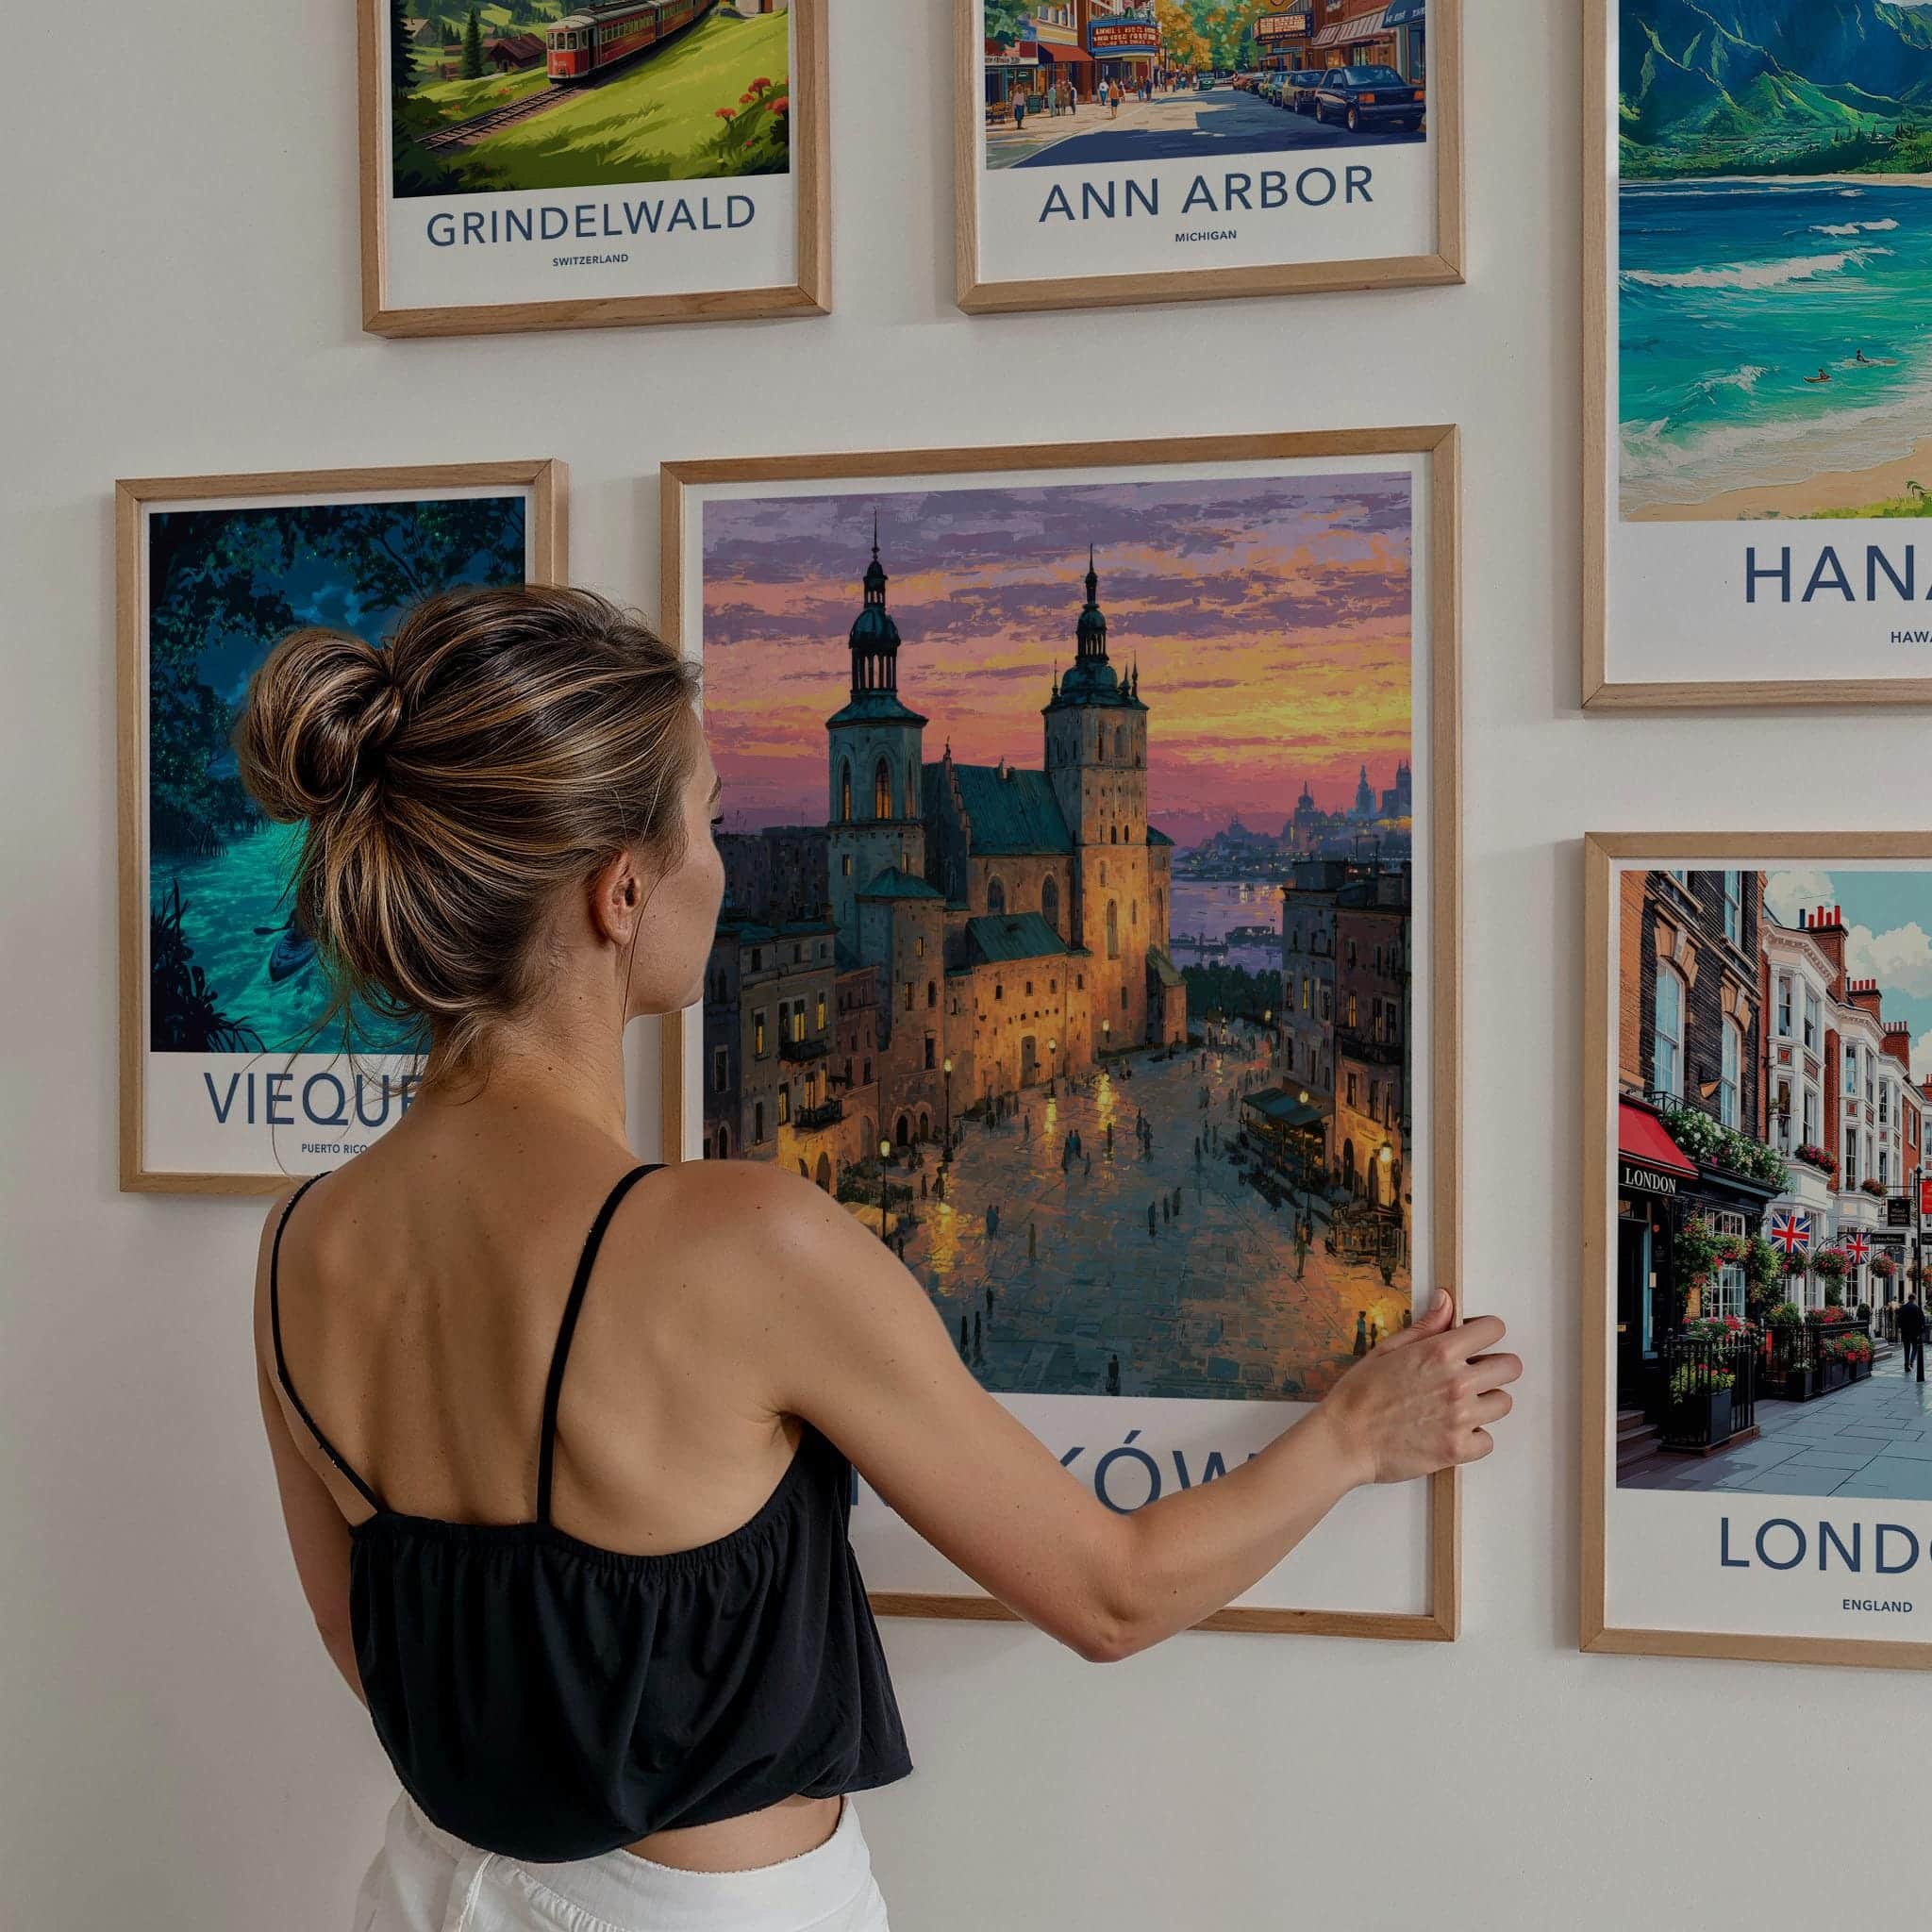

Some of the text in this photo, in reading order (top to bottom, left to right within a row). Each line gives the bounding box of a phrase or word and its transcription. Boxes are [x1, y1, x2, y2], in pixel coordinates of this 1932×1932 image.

[1039, 165, 1374, 223] ANN ARBOR
[427, 194, 756, 247] GRINDELWALD
[1174, 229, 1238, 242] MICHIGAN
[552, 254, 629, 267] SWITZERLAND
[1745, 544, 1932, 603] HAN
[1890, 630, 1932, 643] HAW
[203, 1072, 425, 1126] VIEQUE
[301, 1143, 367, 1154] PUERTO RICO
[1625, 1167, 1676, 1194] LONDON
[1721, 1517, 1932, 1574] LOND
[1842, 1598, 1913, 1613] ENGLAND
